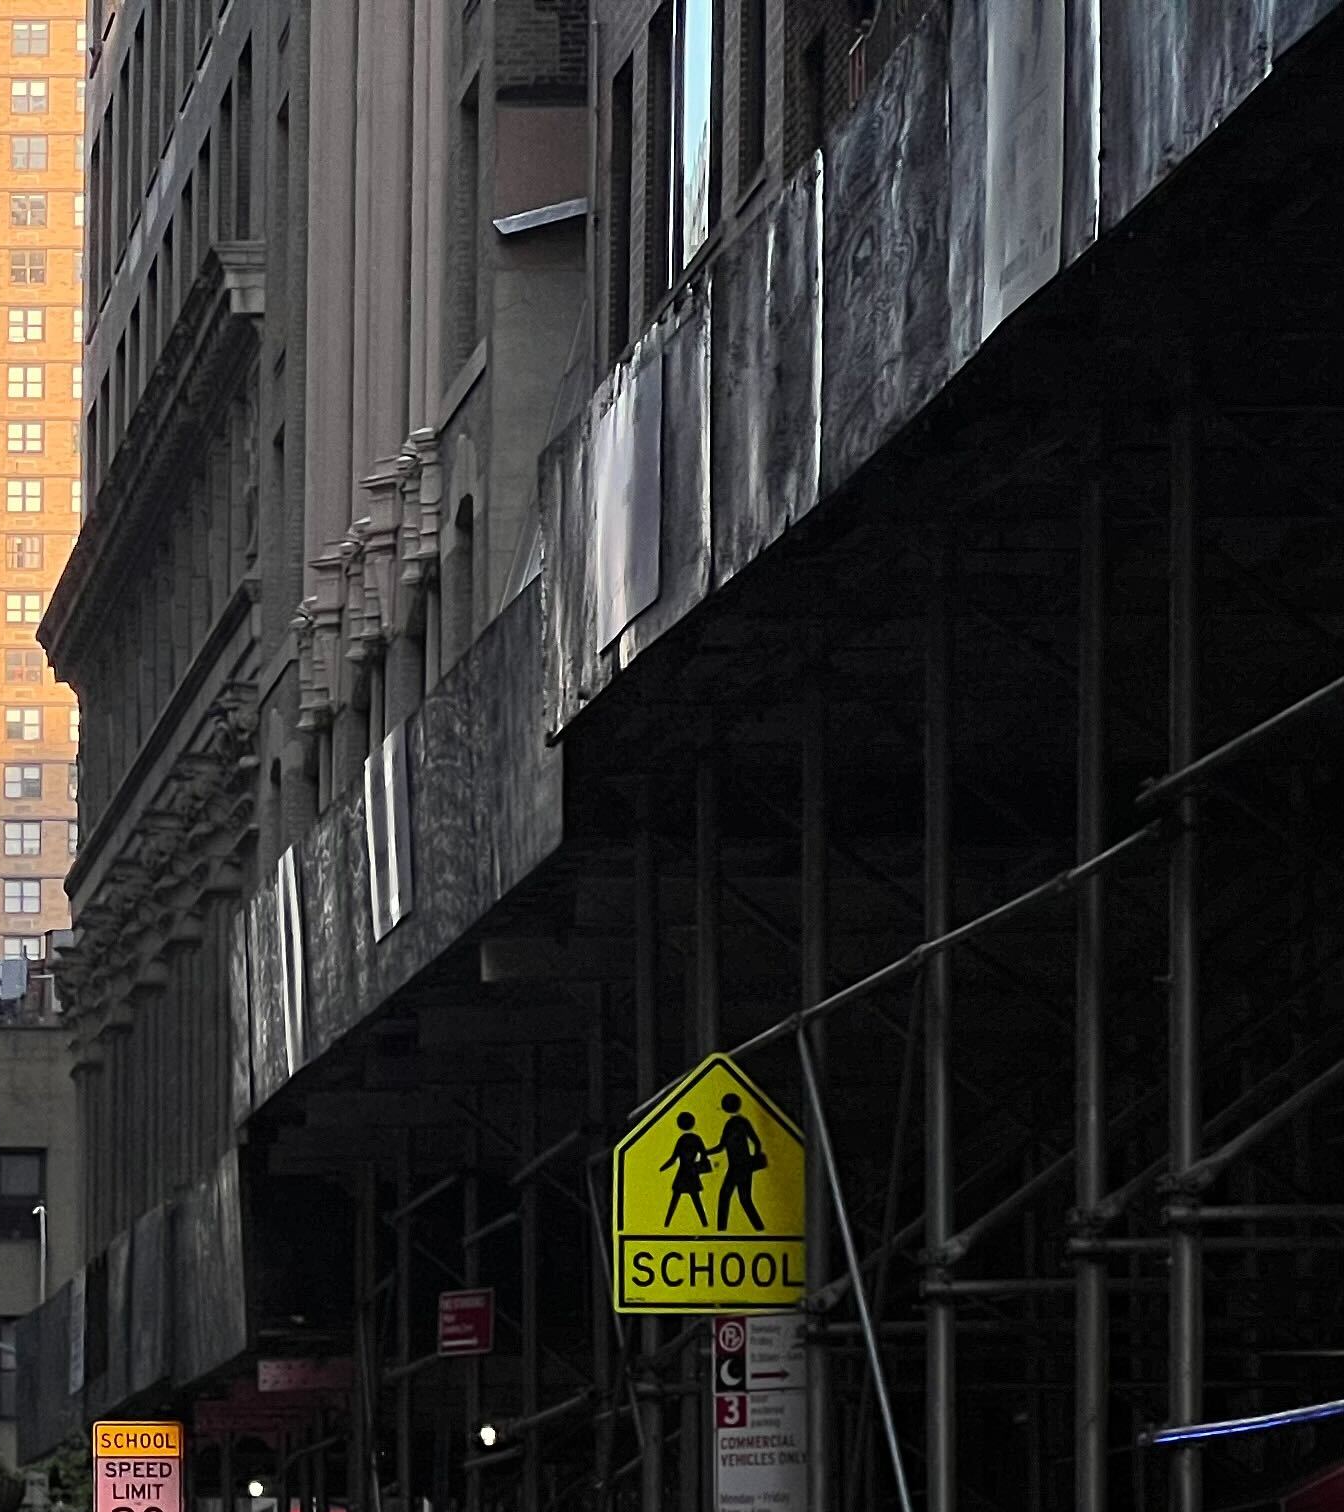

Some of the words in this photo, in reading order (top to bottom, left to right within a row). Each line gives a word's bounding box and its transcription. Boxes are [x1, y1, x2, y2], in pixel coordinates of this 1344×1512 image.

[631, 1251, 805, 1288] SCHOOL
[723, 1396, 740, 1425] 3
[101, 1432, 177, 1449] SCHOOL
[720, 1434, 796, 1450] COMMERCIAL
[720, 1453, 776, 1467] VEHICLES
[778, 1451, 808, 1466] ONLY
[105, 1461, 172, 1478] SPEED
[112, 1483, 164, 1500] LIMIT
